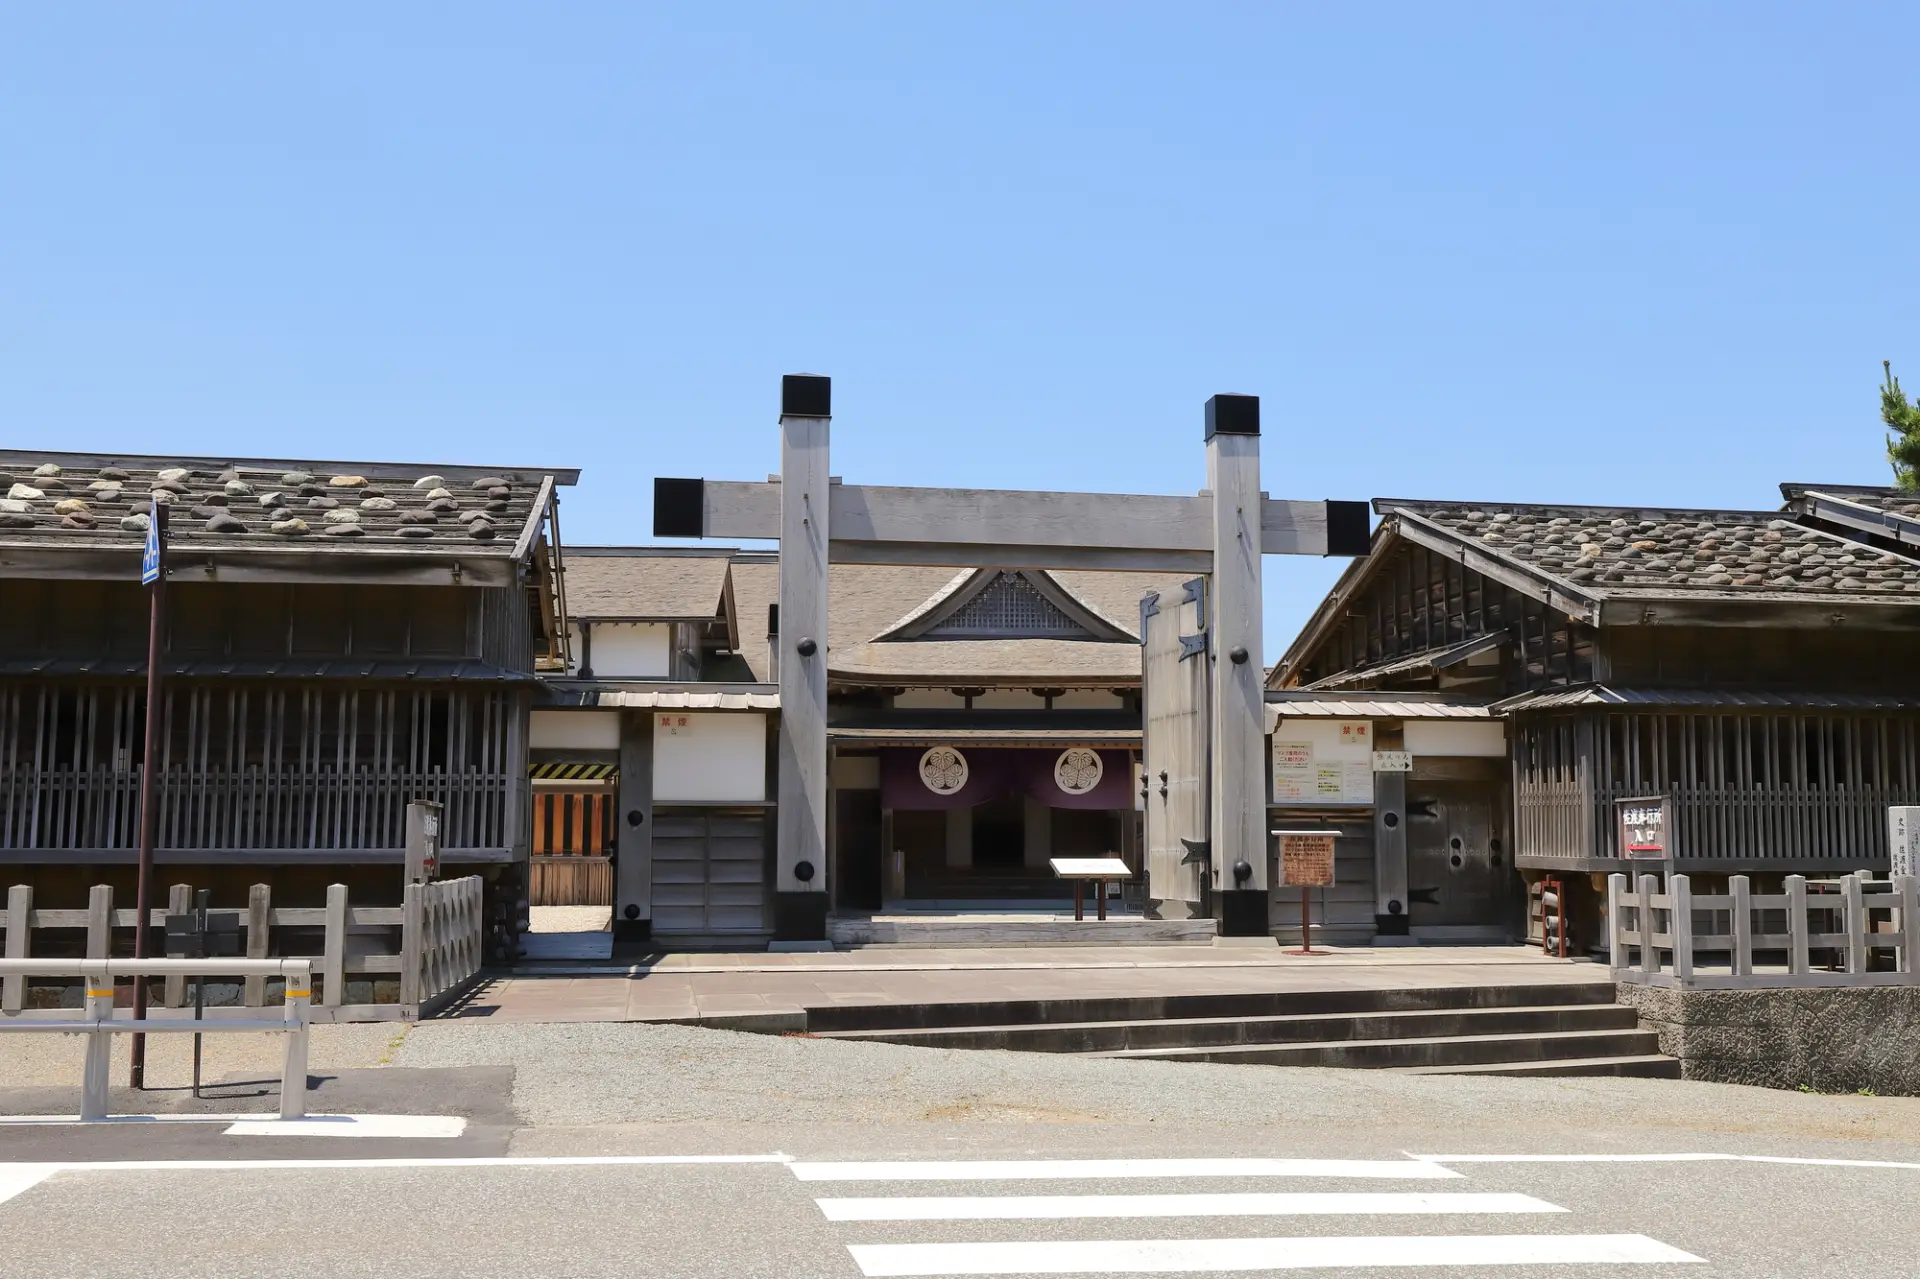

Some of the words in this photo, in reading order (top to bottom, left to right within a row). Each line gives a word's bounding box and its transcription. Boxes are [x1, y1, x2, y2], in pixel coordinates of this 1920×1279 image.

[1342, 726, 1366, 735] 禁煙
[1623, 807, 1662, 825] 佐渡奉行所
[1634, 829, 1656, 842] 入口
